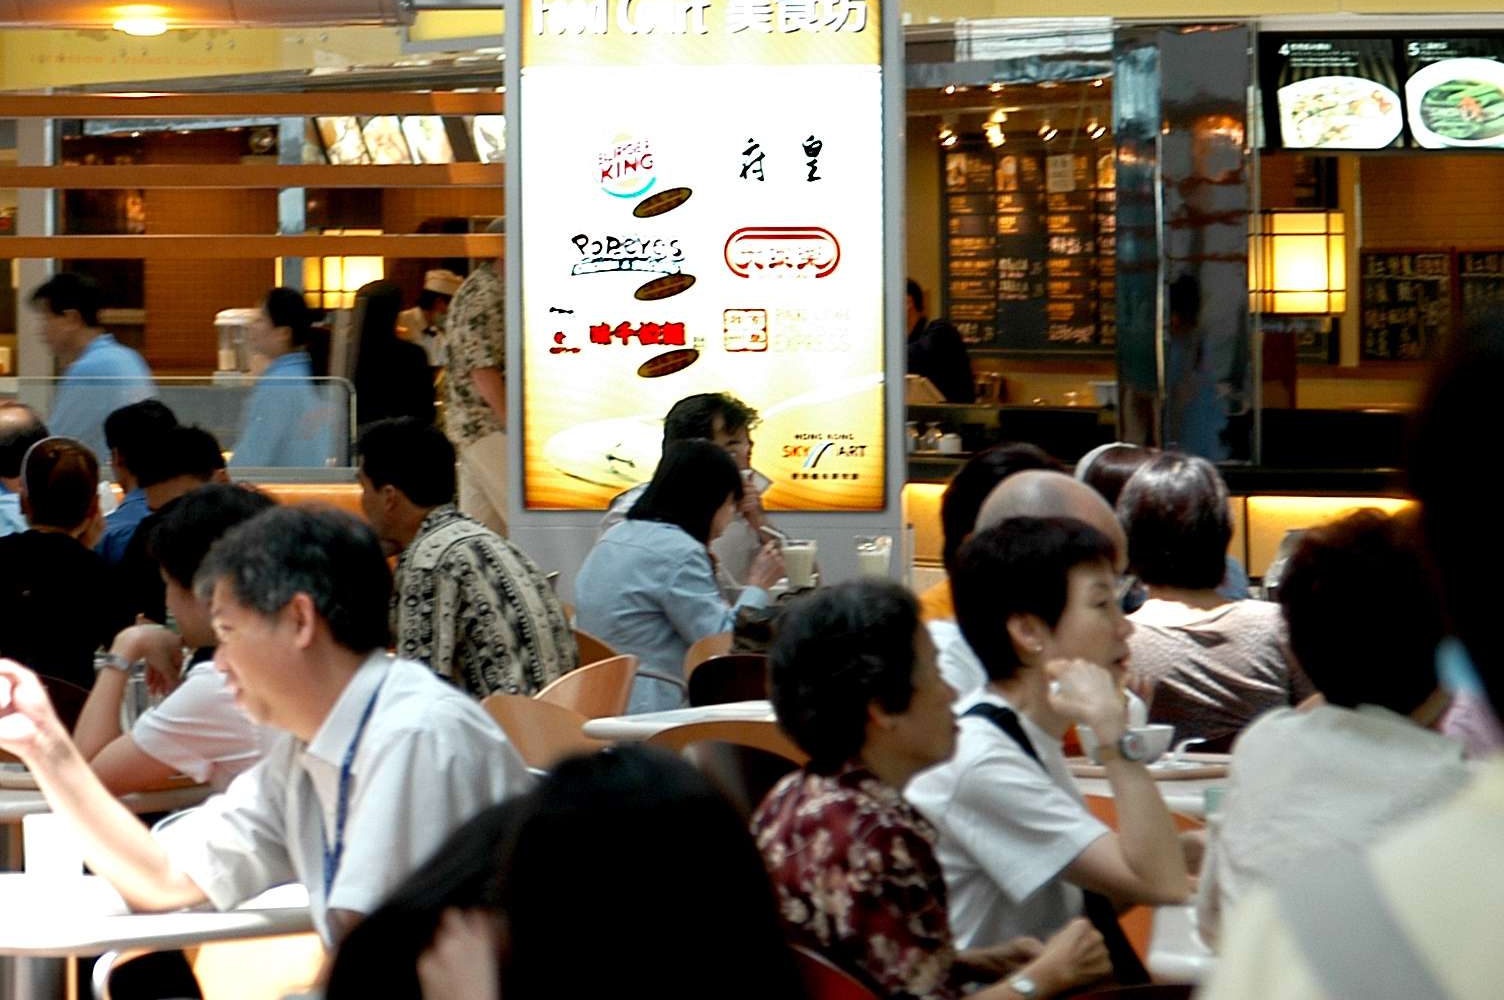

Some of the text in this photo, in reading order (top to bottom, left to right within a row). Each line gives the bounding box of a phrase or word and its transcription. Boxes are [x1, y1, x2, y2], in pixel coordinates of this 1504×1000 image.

[1277, 43, 1290, 56] 4
[1407, 42, 1420, 57] 5
[599, 152, 654, 184] KING
